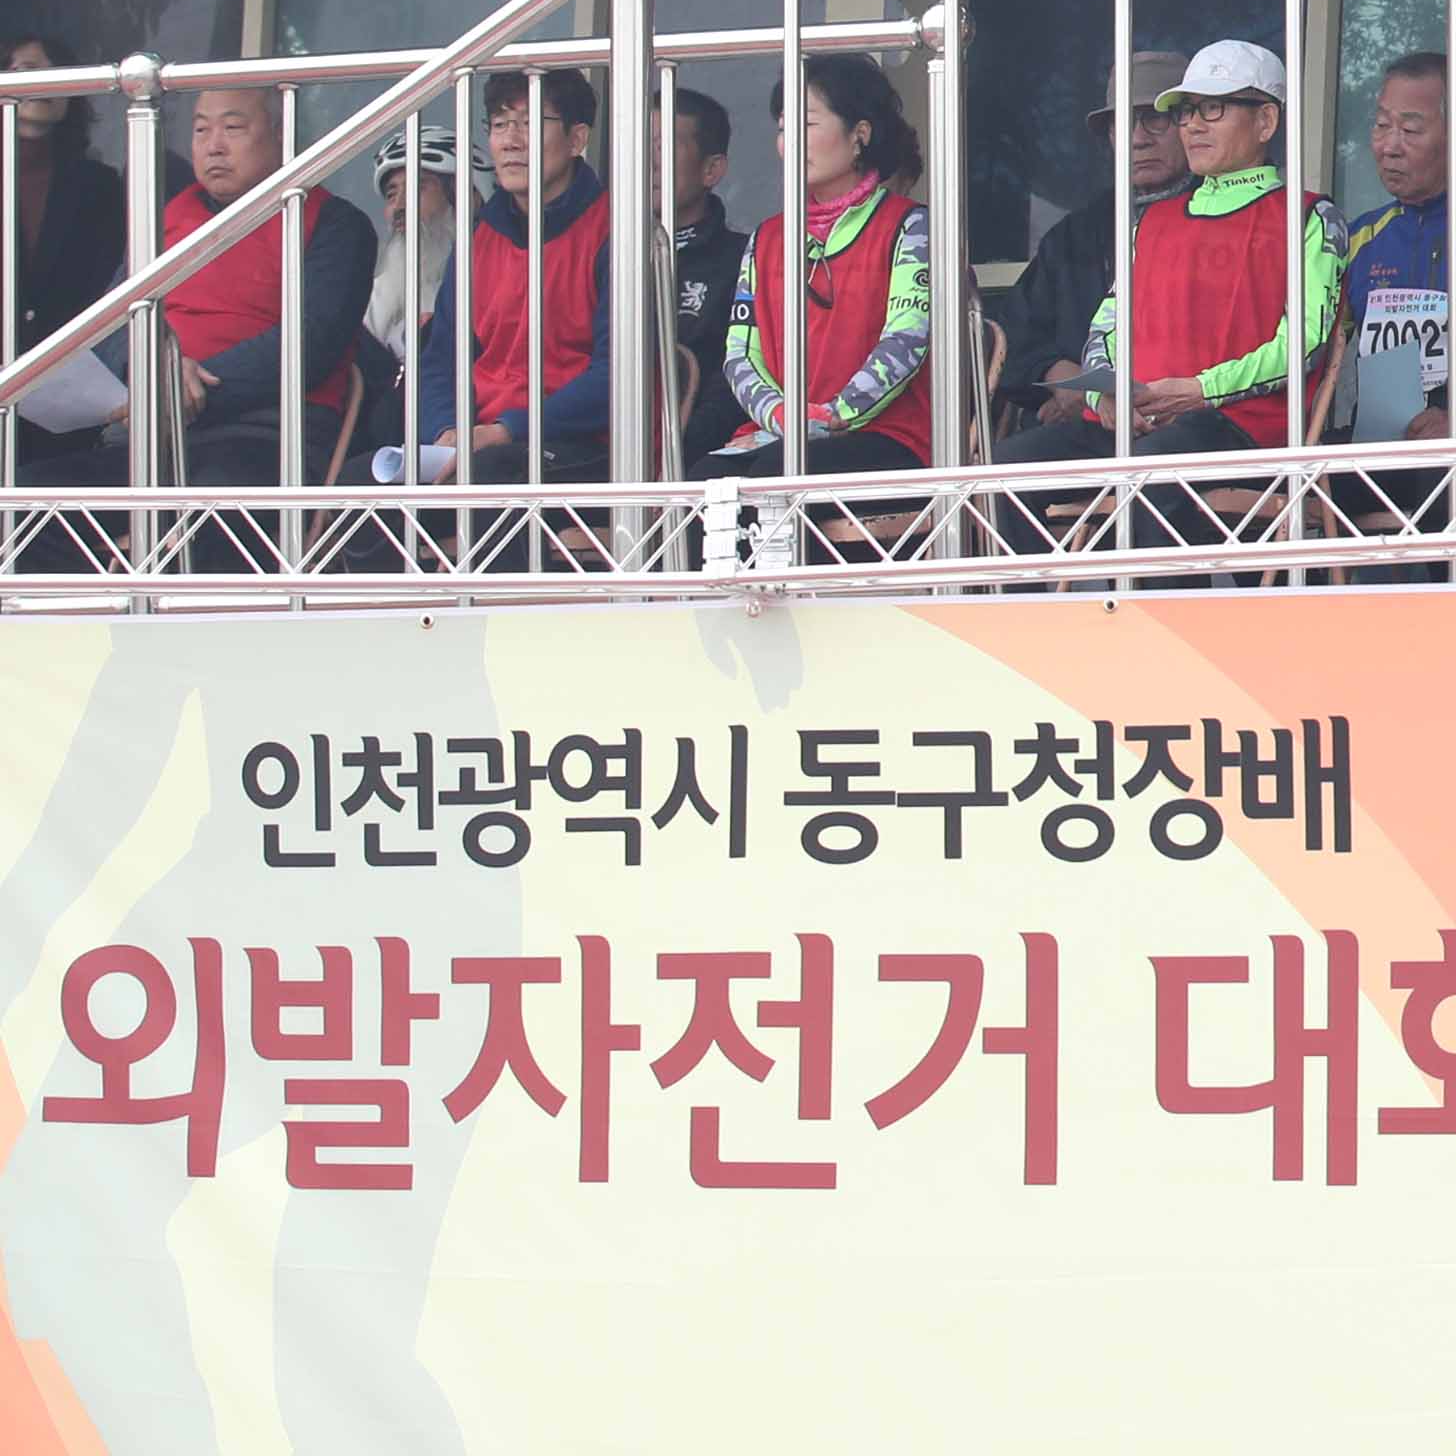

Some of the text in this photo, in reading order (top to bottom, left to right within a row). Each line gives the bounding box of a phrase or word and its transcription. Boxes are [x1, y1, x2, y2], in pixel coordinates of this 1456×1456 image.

[1223, 173, 1264, 187] Tinkoff
[890, 296, 929, 312] Tinko
[1366, 319, 1448, 357] 7002
[242, 717, 1352, 867] 인천광역시 동구청장배
[42, 933, 1057, 1189] 외발자전거
